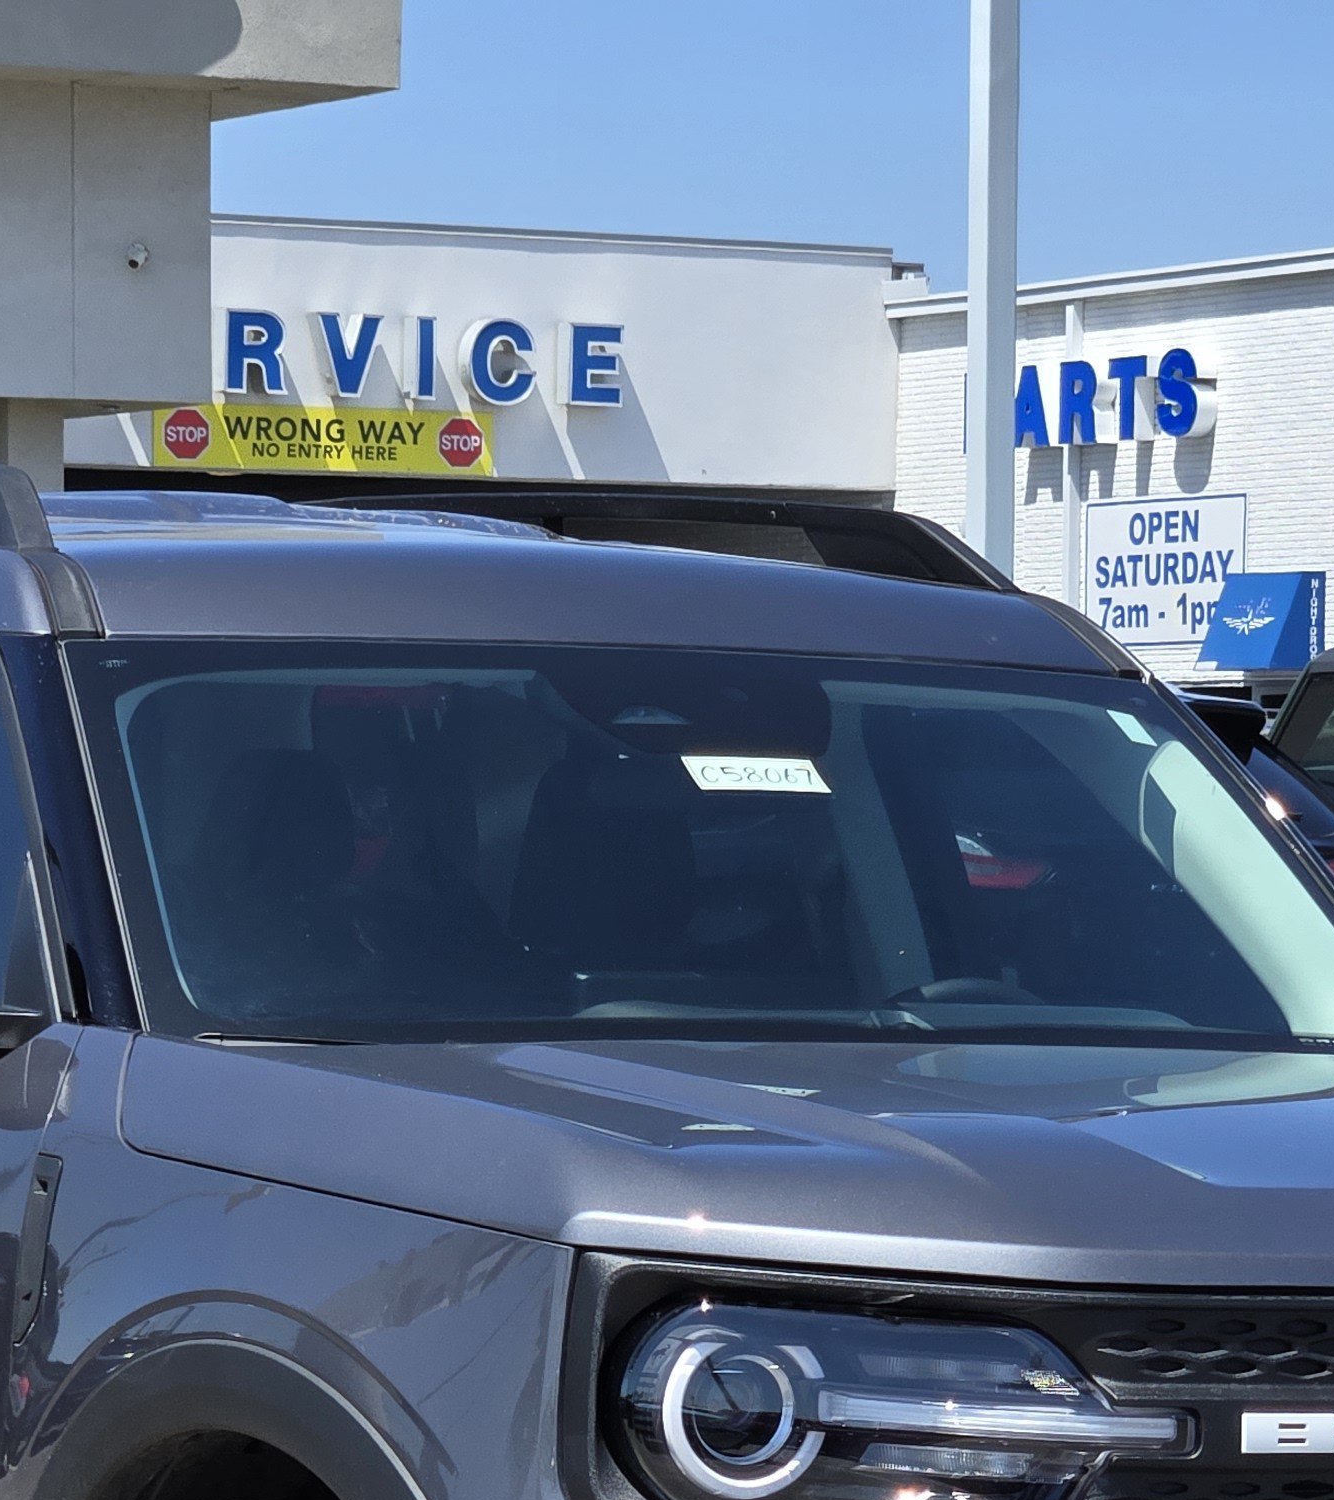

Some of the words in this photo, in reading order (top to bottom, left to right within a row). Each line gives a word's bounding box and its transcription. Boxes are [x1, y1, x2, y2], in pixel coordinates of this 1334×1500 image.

[963, 348, 1197, 450] ARTS
[165, 425, 207, 445] STOP
[224, 414, 347, 445] WRONG
[358, 420, 425, 447] WAY
[440, 433, 481, 453] STOP
[251, 442, 281, 459] NO
[286, 442, 346, 461] ENTRY
[351, 444, 397, 462] HERE
[1128, 509, 1199, 545] OPEN
[1095, 549, 1234, 589] SATURDAY
[1098, 596, 1149, 632] 7am
[700, 765, 813, 785] C58067
